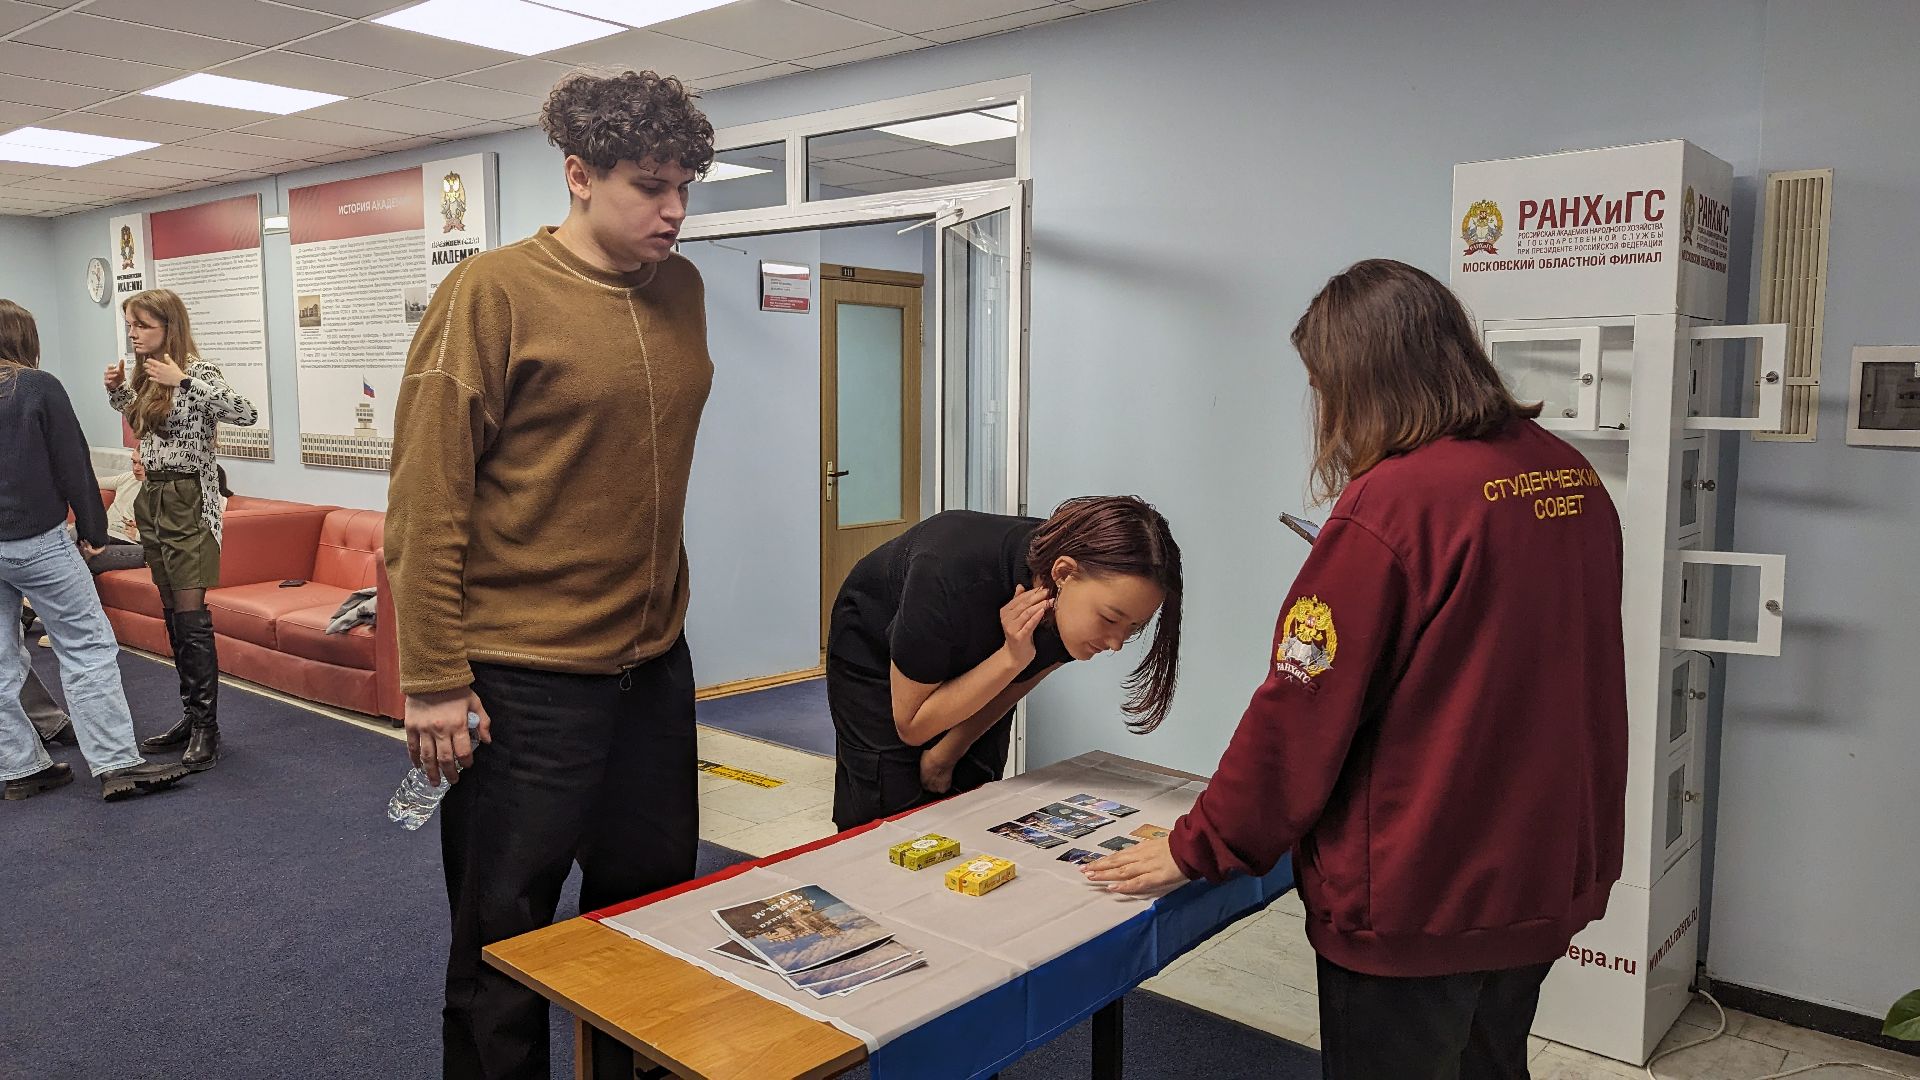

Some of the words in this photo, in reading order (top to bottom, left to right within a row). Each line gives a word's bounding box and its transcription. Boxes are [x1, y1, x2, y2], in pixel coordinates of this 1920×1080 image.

[338, 201, 371, 215] ИСТОРИЯ
[1519, 190, 1665, 230] РАНХиГС
[1589, 224, 1626, 234] НАРОДНОГО
[1527, 233, 1616, 246] ГОСУДАРСТВЕННОЙ
[1531, 245, 1572, 254] ПРЕЗИДЕНТЕ
[1574, 241, 1618, 251] РОССИЙСКОЙ
[1620, 239, 1662, 249] ФЕДЕРАЦИИ
[1463, 257, 1534, 272] МОСКОВСКИЙ
[1539, 253, 1607, 269] ОБЛАСТНОЙ
[1610, 252, 1662, 264] ФИЛИАЛ
[1534, 494, 1584, 519] СОВЕТ
[1568, 944, 1637, 975] epa.ru
